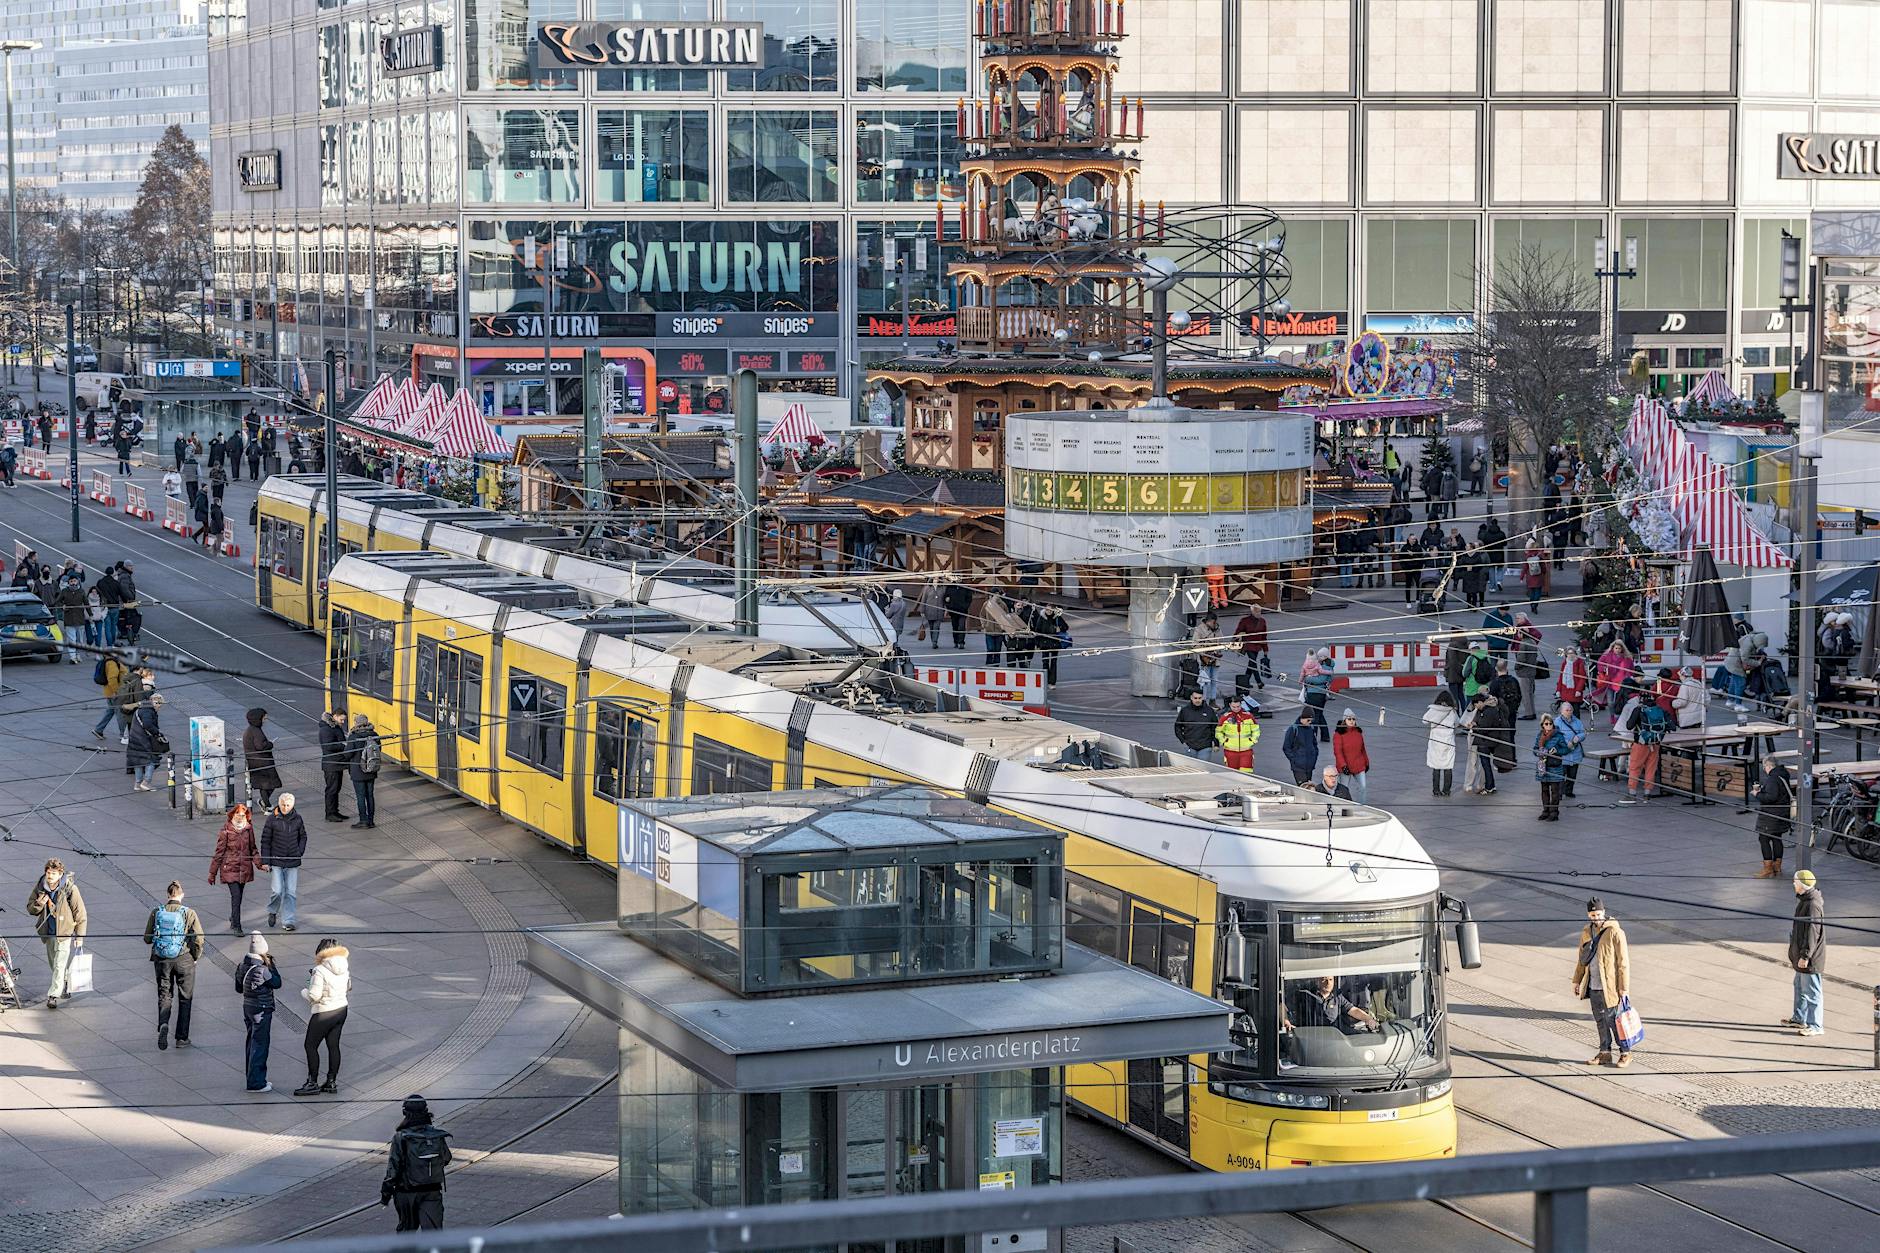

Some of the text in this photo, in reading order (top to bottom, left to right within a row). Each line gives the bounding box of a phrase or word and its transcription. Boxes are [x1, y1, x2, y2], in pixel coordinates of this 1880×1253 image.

[394, 31, 430, 71] SATURN
[615, 27, 758, 63] SATURN
[529, 149, 575, 160] SAMSUNG
[1833, 139, 1880, 173] SAT
[609, 241, 801, 293] SATURN
[673, 317, 717, 336] snipes
[764, 317, 809, 336] snipes
[907, 314, 955, 336] YORKER
[1251, 313, 1338, 335] NEW YORKER
[1660, 313, 1687, 331] JD
[1767, 312, 1785, 331] JD
[158, 363, 170, 376] U
[504, 362, 572, 374] xperon
[678, 354, 705, 371] -50%
[740, 361, 773, 369] WEEK
[799, 354, 825, 371] -50%
[1041, 478, 1053, 502] 3
[1066, 480, 1083, 503] 4
[1103, 481, 1119, 504] 5
[1140, 481, 1158, 505] 6
[1178, 481, 1198, 505] 7
[620, 810, 634, 865] U
[658, 830, 670, 851] U8
[658, 859, 670, 881] U5
[895, 1033, 1081, 1067] U Alexanderplatz
[1227, 1153, 1261, 1171] A-9094
